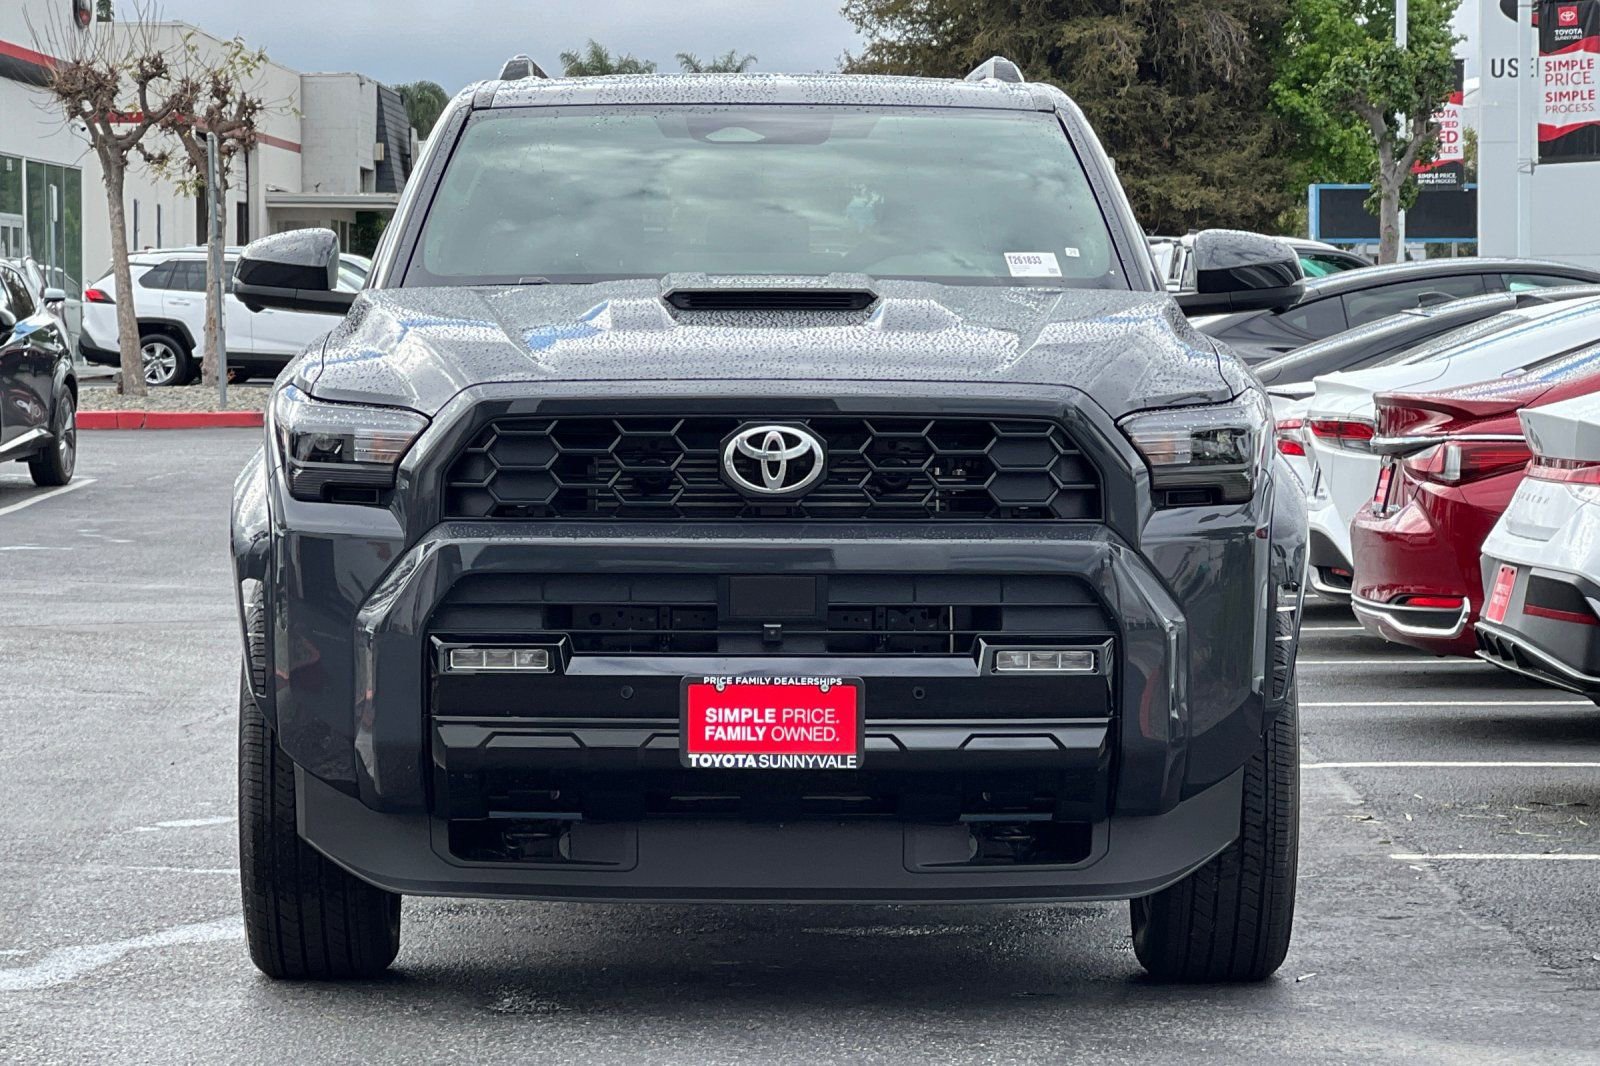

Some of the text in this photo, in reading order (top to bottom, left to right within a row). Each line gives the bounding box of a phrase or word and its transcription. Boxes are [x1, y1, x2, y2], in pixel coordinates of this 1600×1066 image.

[1545, 58, 1595, 72] SIMPLE
[1545, 71, 1595, 86] PRICE.
[1545, 89, 1595, 103] SIMPLE
[703, 676, 842, 686] PRICE FAMILY DEALERSHIPS
[705, 708, 840, 724] SIMPLE PRICE.
[704, 726, 840, 742] FAMILY OWNED.
[688, 754, 857, 768] TOYOTA SUNNYVALE
